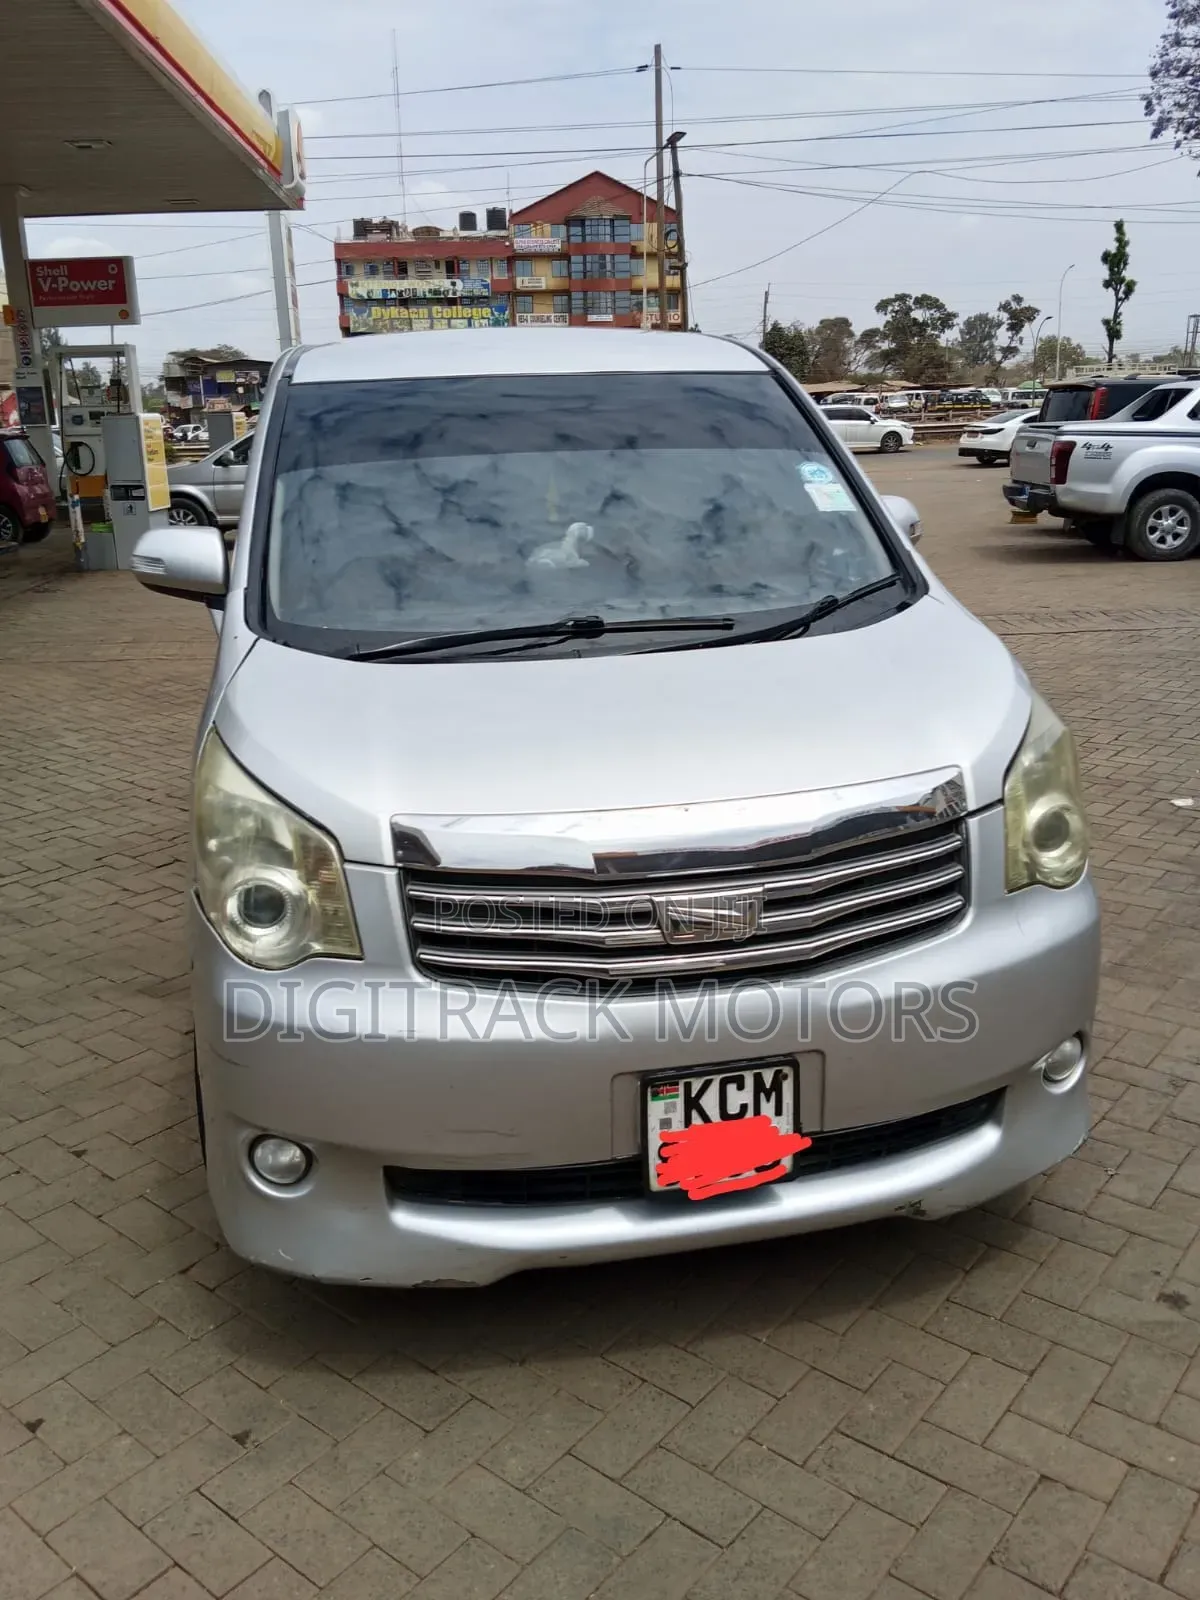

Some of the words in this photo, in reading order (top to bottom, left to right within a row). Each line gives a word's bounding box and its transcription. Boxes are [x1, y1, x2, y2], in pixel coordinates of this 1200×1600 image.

[36, 264, 68, 276] Shell
[38, 276, 116, 293] V-Power
[432, 305, 491, 319] College
[645, 312, 680, 321] STUIO
[683, 1068, 784, 1128] KCM
